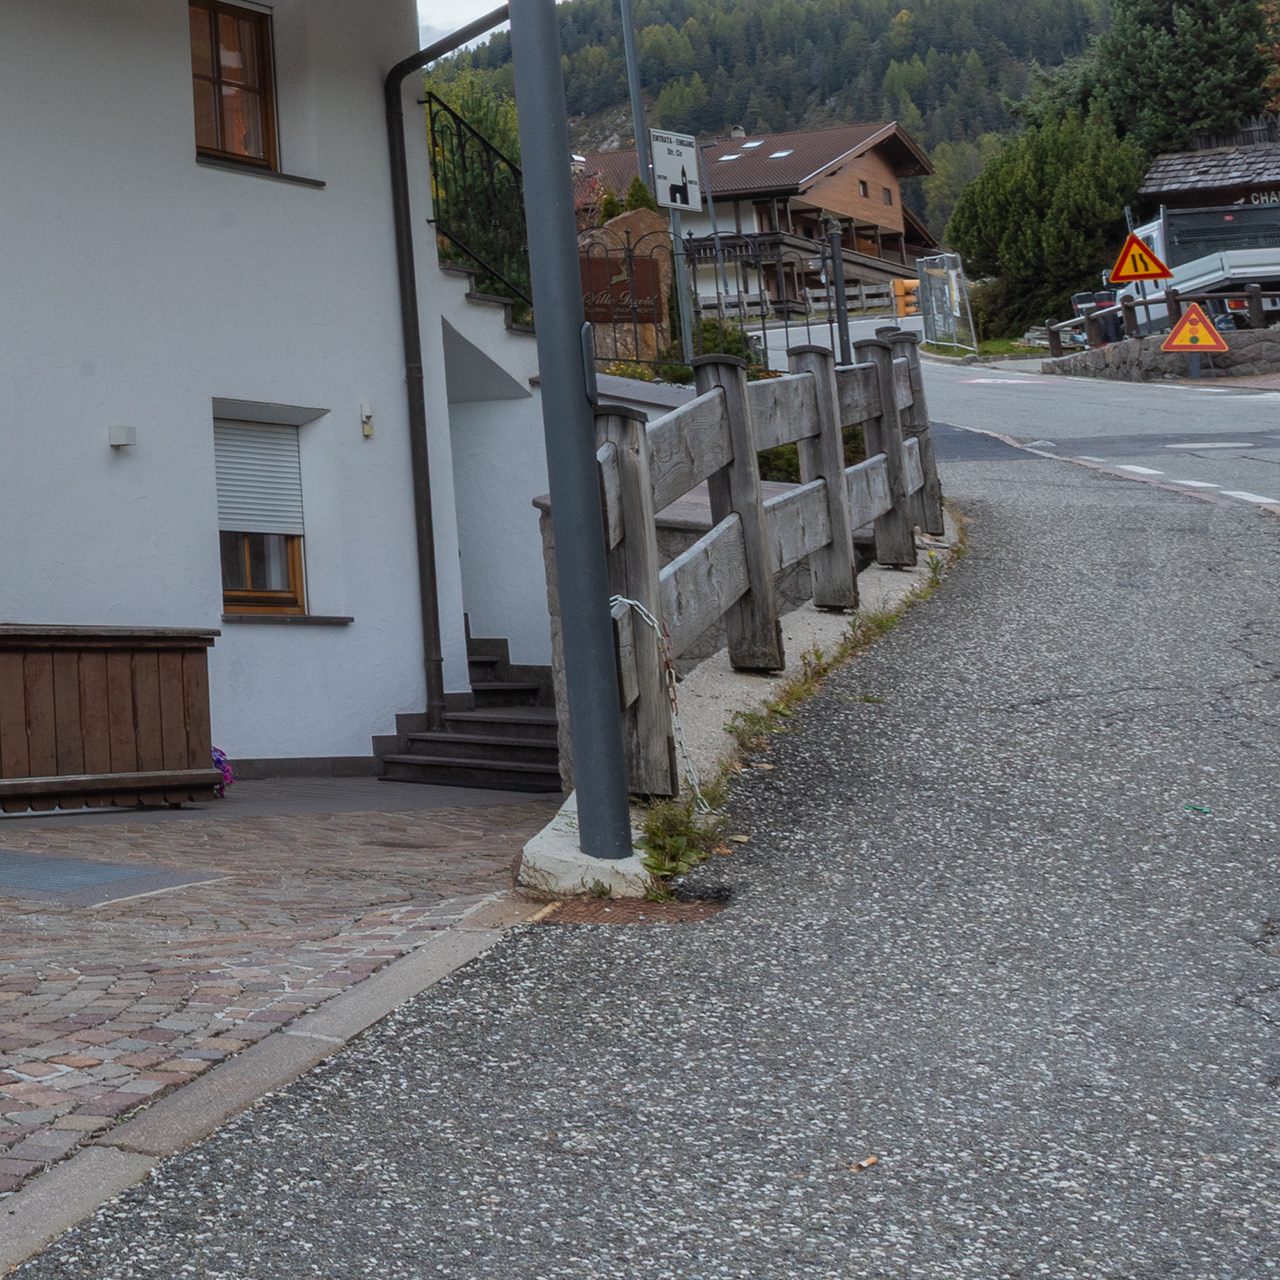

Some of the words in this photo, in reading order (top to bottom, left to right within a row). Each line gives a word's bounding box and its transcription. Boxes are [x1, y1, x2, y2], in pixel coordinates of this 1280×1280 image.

[652, 134, 673, 145] ENTRATA
[676, 138, 695, 149] EINGANG
[1250, 190, 1280, 205] CHA
[619, 291, 658, 306] Dvid
